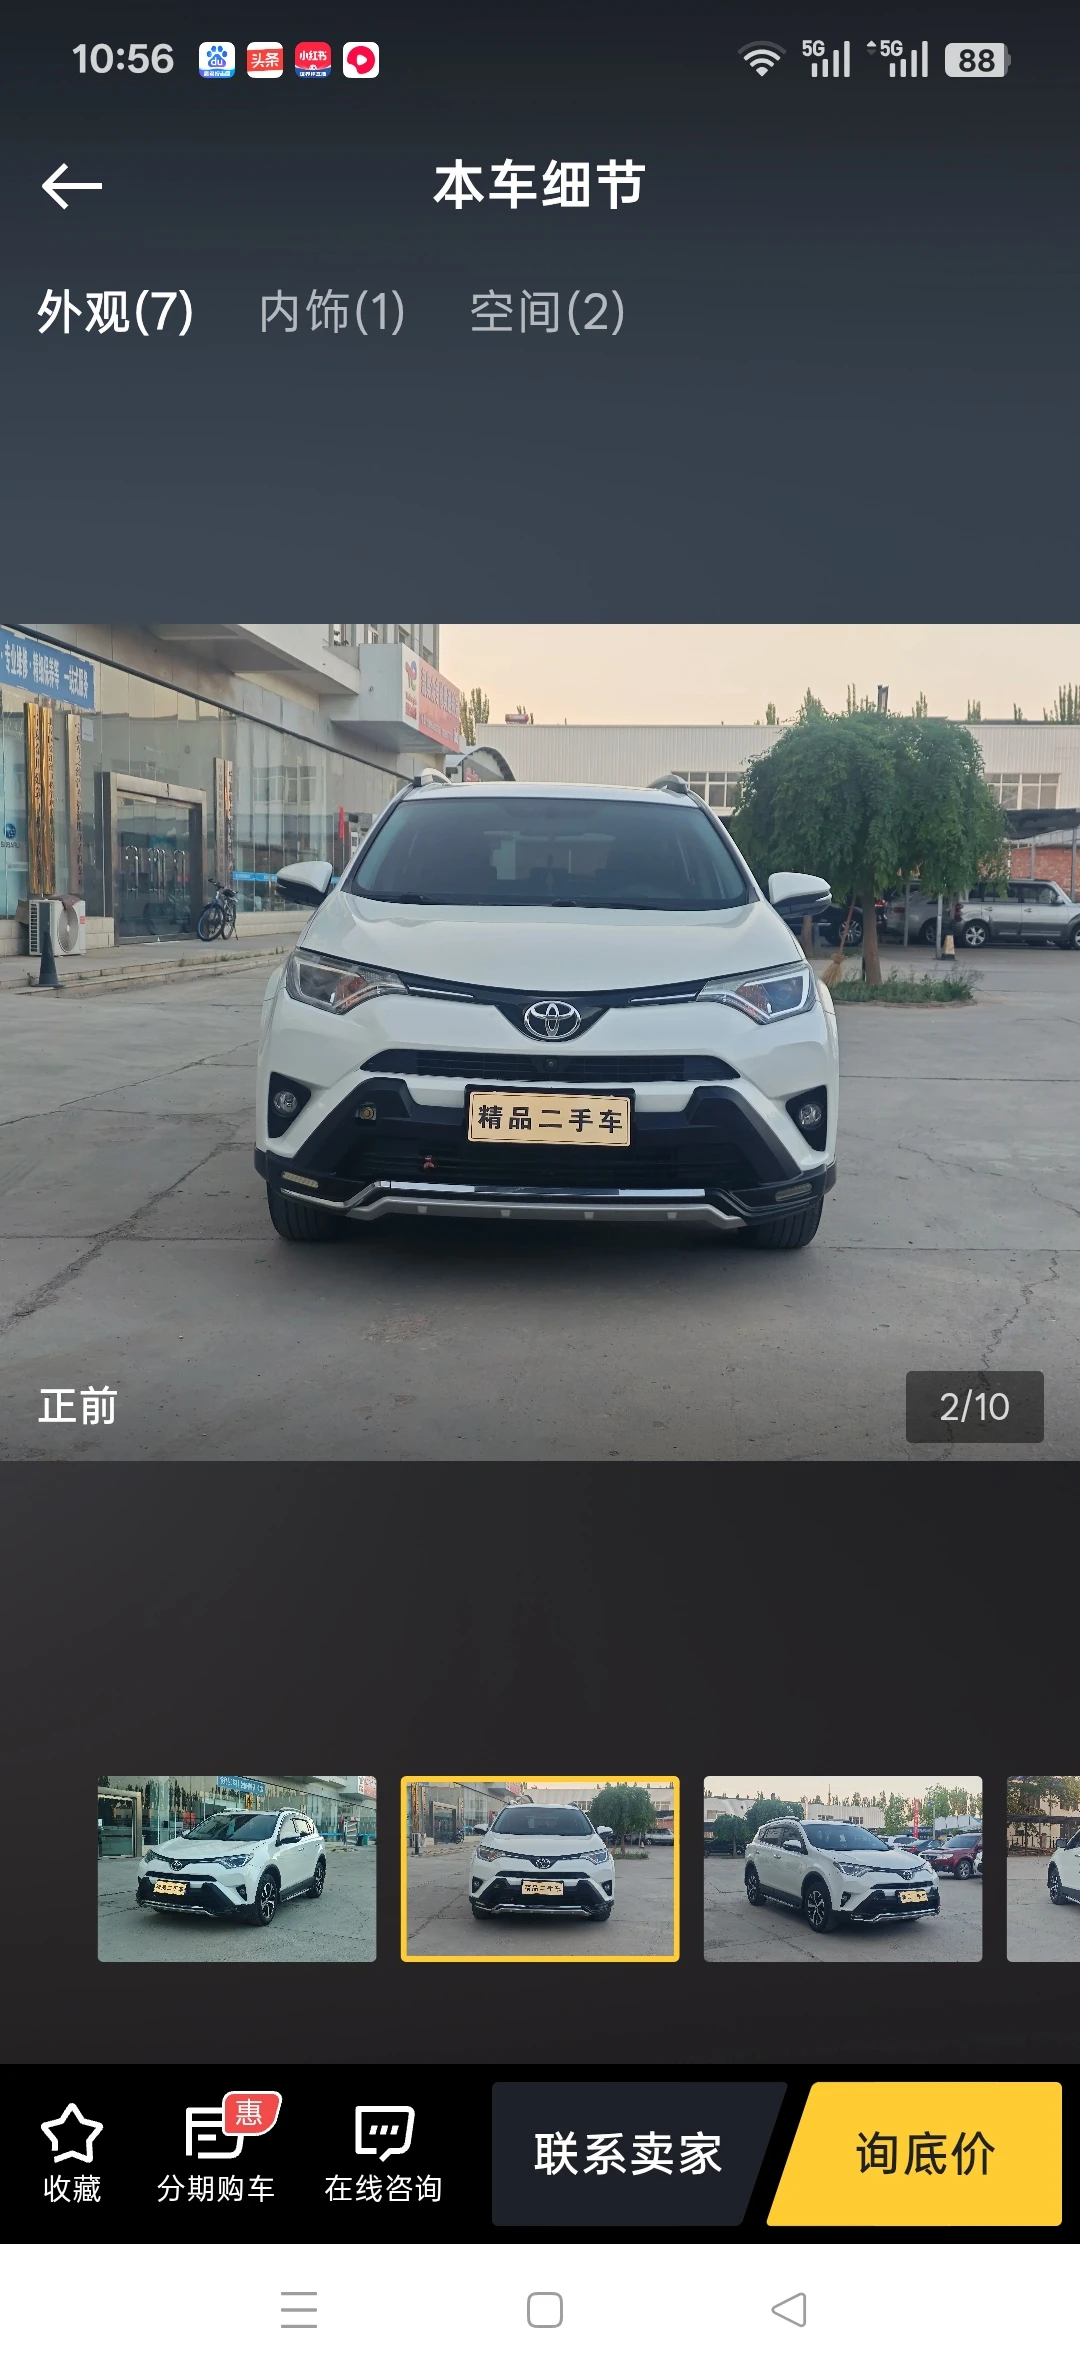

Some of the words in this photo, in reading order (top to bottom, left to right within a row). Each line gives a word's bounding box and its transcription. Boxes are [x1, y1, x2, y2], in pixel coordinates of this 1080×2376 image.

[73, 43, 174, 74] 10:56
[210, 57, 223, 66] du
[251, 52, 280, 69] 头条
[300, 50, 328, 61] 小红书
[802, 40, 826, 57] 5G
[880, 40, 904, 57] 5G
[959, 49, 996, 73] 88
[433, 158, 646, 210] 本车细节
[37, 289, 193, 336] 外观(7)
[261, 289, 404, 336] 内饰(1)
[470, 289, 624, 336] 空间(2)
[477, 1104, 623, 1134] 精品二手车
[38, 1386, 118, 1425] 正前
[940, 1388, 1010, 1424] 2/10
[235, 2098, 263, 2126] 惠
[534, 2131, 723, 2176] 联系卖家
[856, 2131, 996, 2176] 询底价
[43, 2174, 102, 2204] 收藏
[156, 2174, 275, 2203] 分期购车
[324, 2174, 442, 2203] 在线咨询
